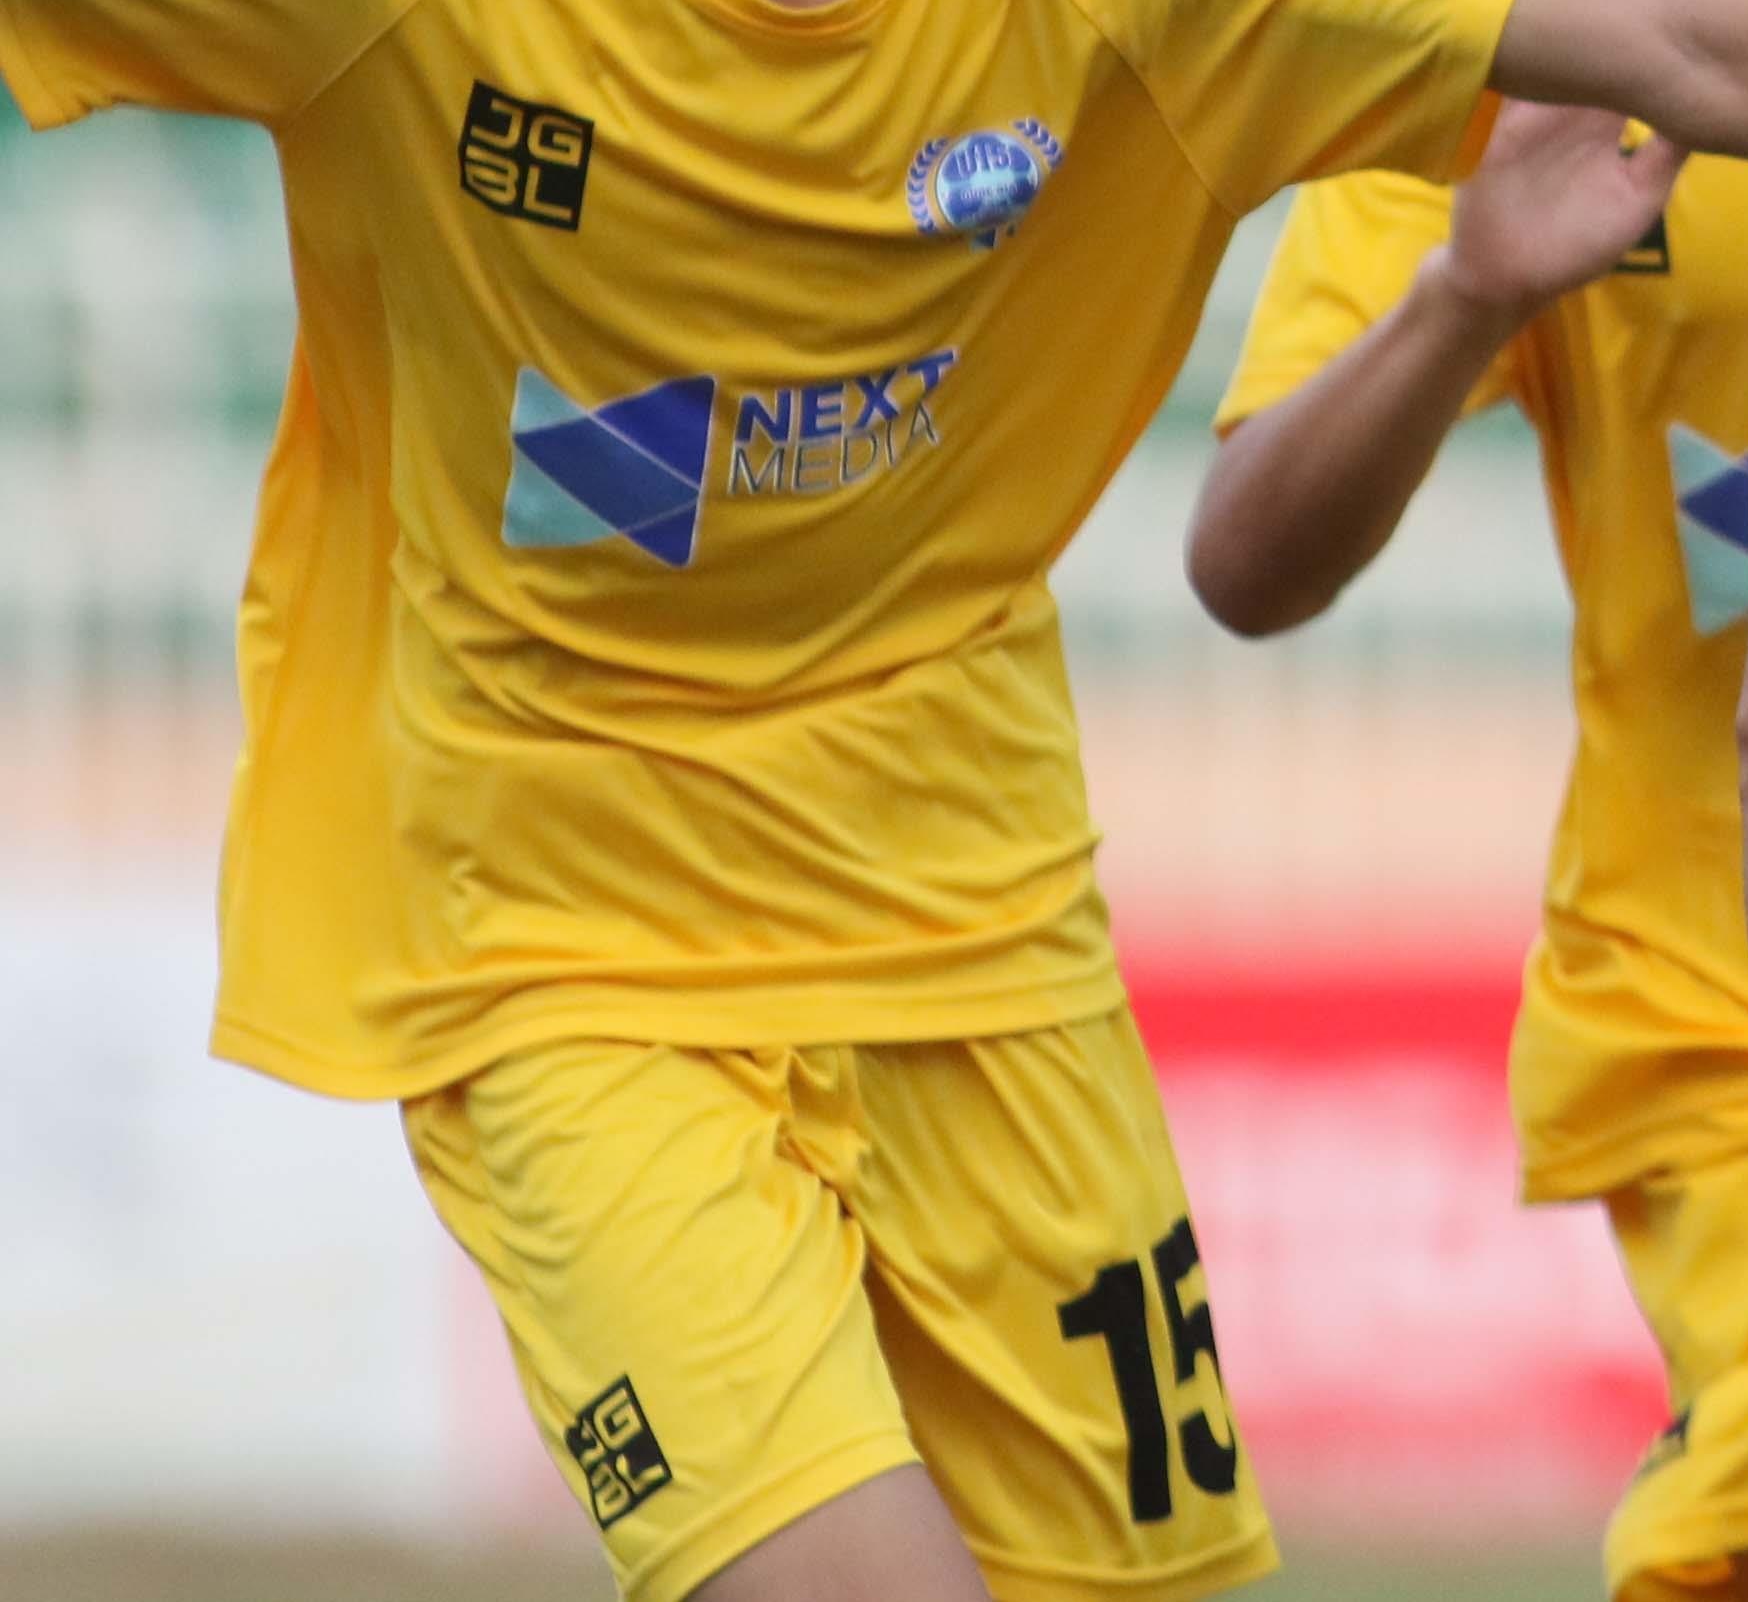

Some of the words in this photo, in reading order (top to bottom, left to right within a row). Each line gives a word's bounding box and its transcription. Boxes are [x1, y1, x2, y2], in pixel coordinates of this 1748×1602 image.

[735, 349, 957, 443] NEXT
[727, 401, 939, 495] MEDIA
[1056, 1215, 1237, 1522] 15
